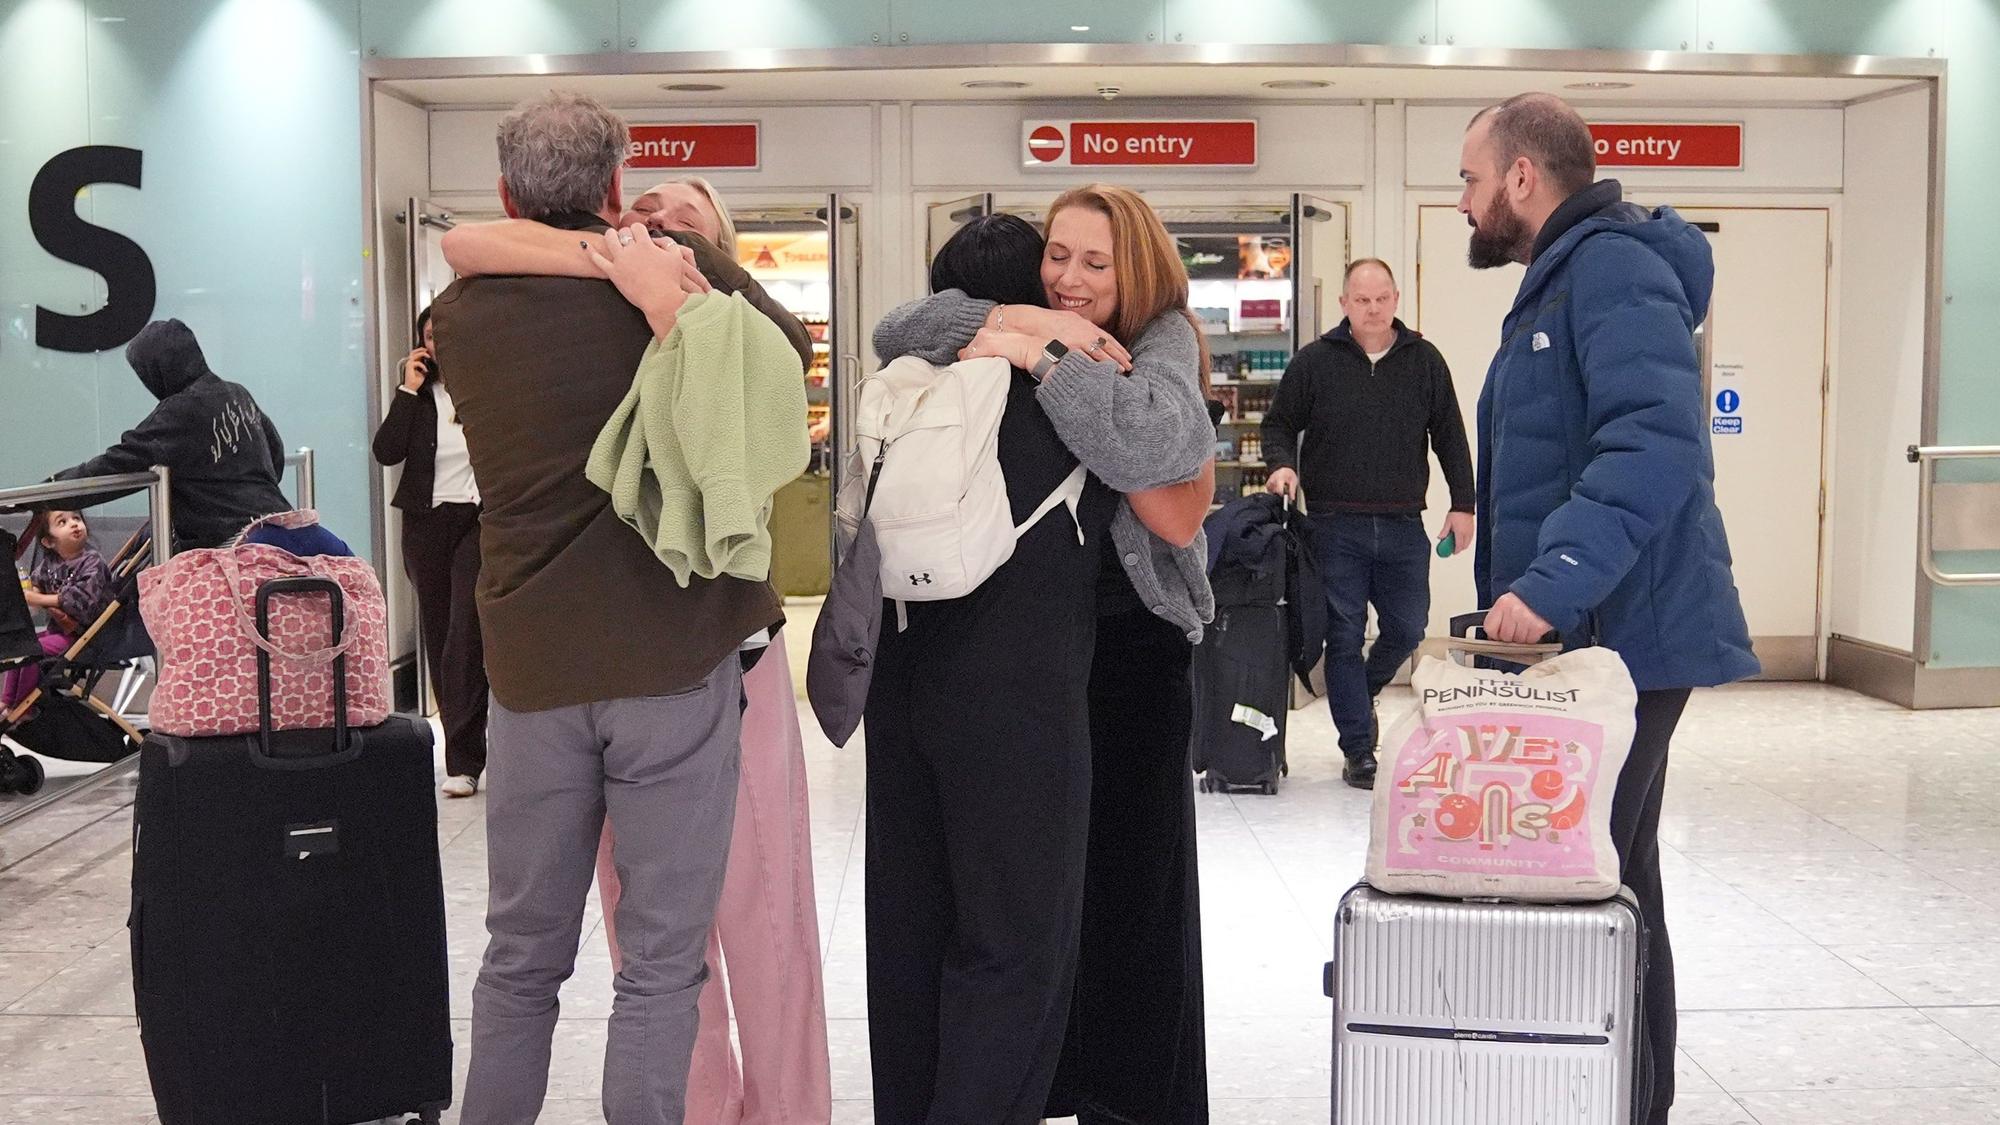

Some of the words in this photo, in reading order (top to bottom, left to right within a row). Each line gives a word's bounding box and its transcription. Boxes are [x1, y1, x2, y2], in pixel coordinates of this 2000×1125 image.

[629, 137, 696, 162] entry
[1083, 133, 1119, 154] No
[1125, 133, 1194, 159] entry
[1594, 138, 1610, 156] o
[1615, 136, 1682, 161] entry
[1713, 425, 1740, 433] Clear
[1714, 417, 1741, 427] Keep
[1474, 677, 1525, 687] THE
[1423, 685, 1581, 704] PENINSULIST
[1437, 855, 1548, 869] COMMUNITY
